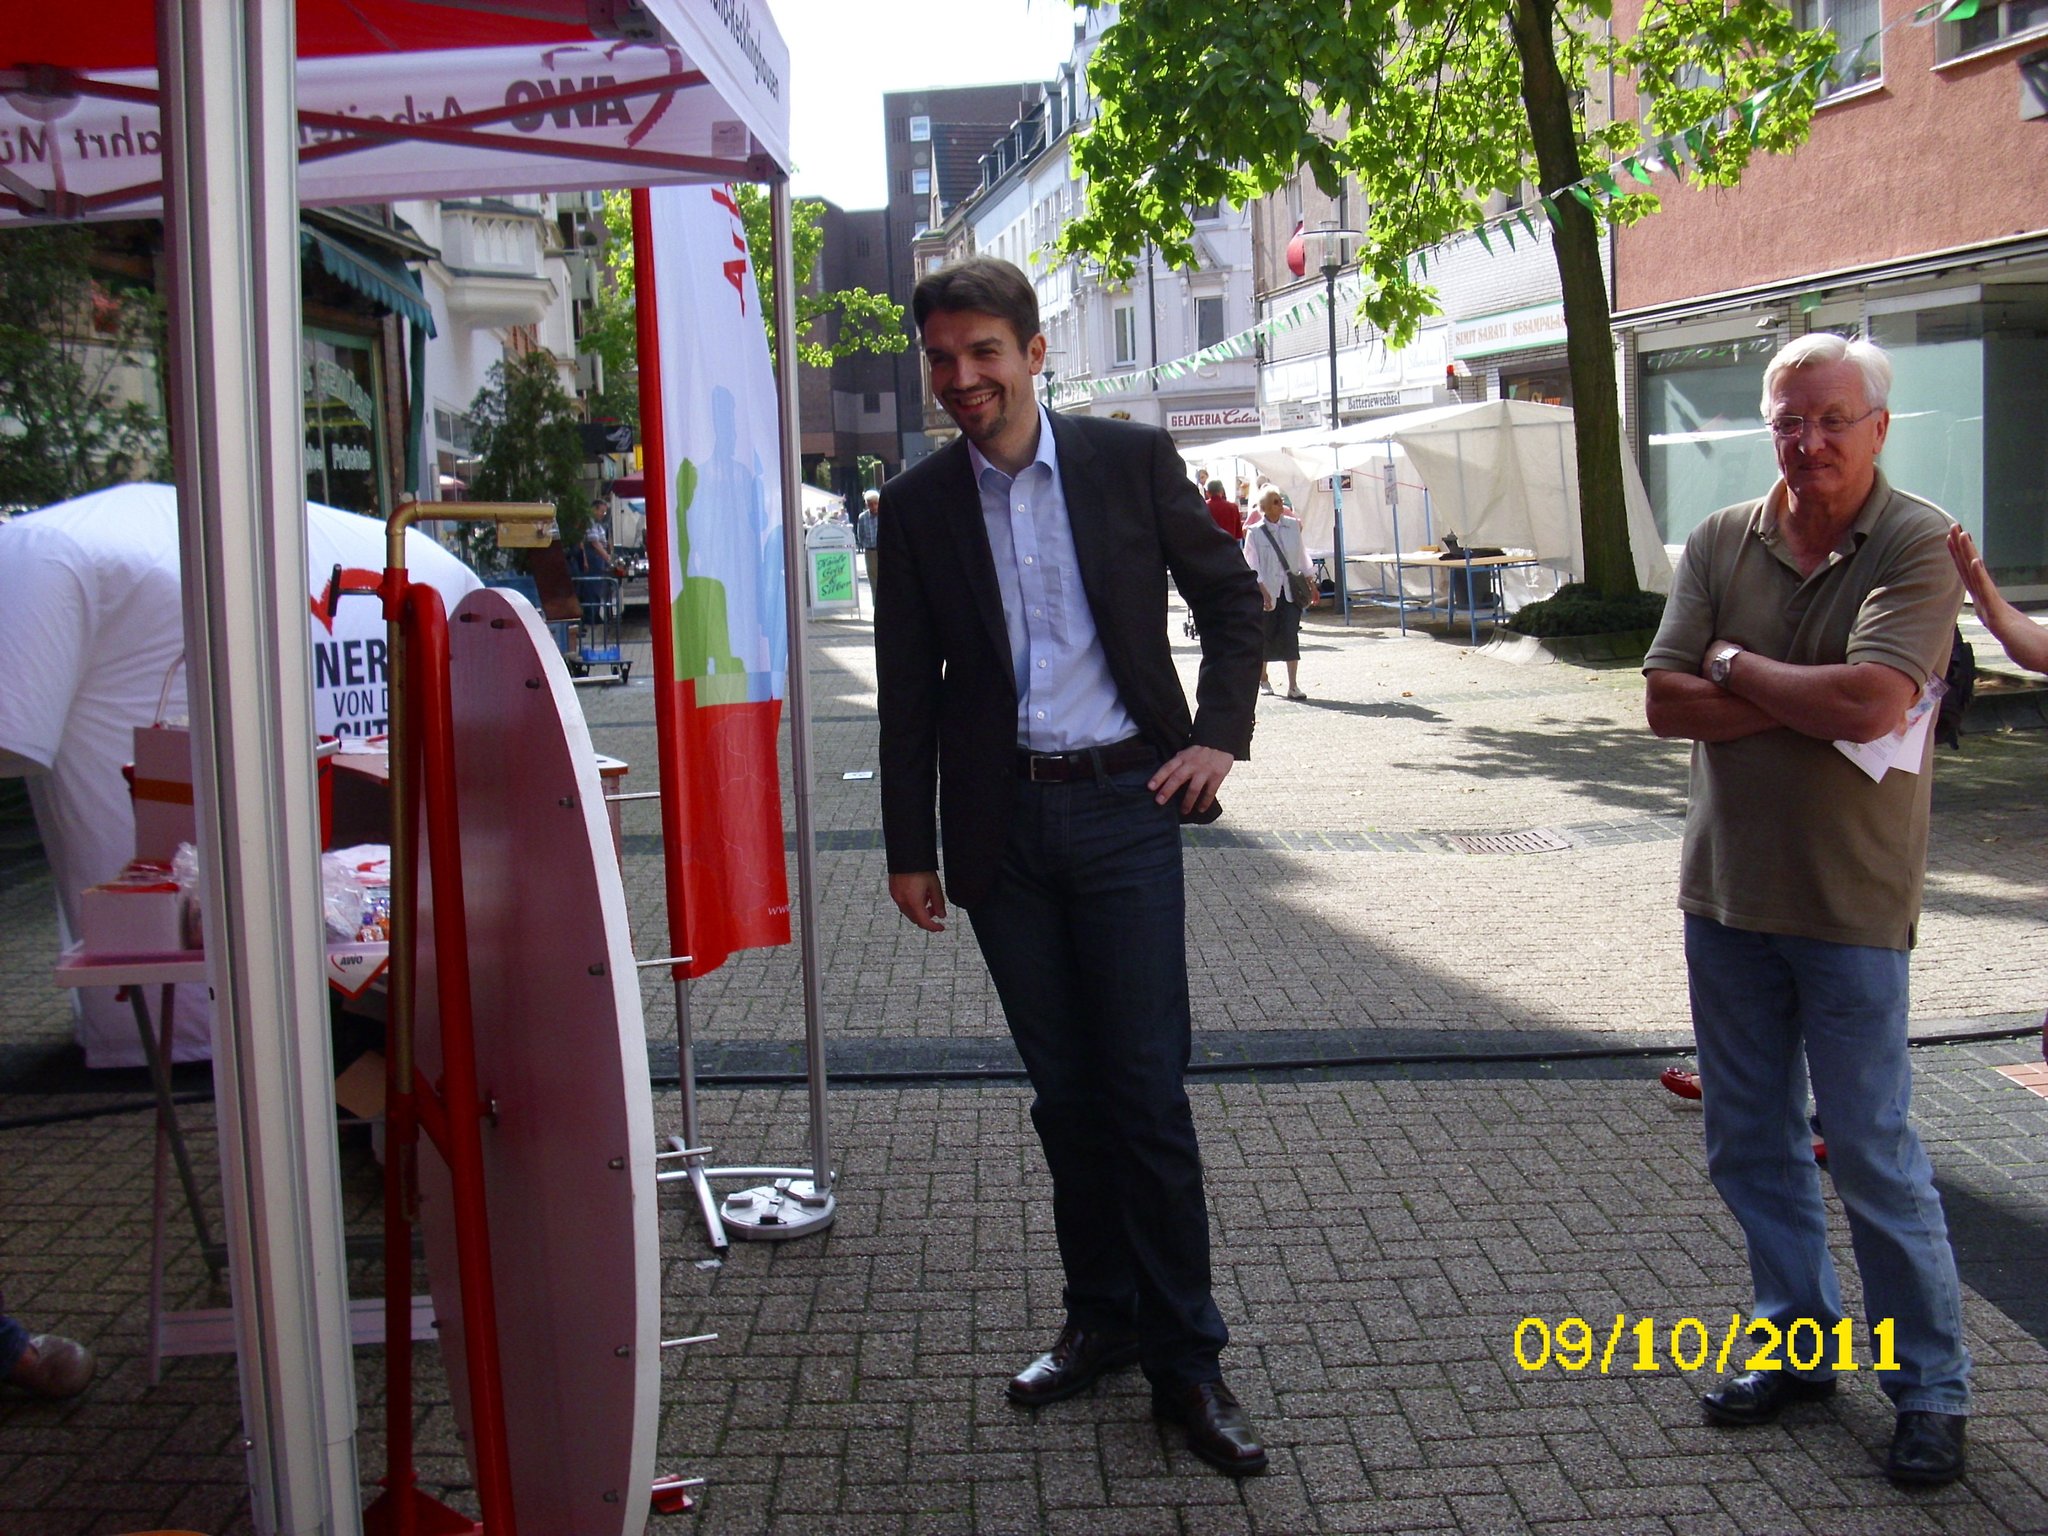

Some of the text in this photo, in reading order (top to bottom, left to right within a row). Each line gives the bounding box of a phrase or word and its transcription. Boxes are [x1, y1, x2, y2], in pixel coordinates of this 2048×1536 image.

[1347, 391, 1401, 410] Batteriewechsel
[1171, 413, 1221, 427] GELATERIA
[333, 690, 373, 717] VON
[341, 956, 362, 965] AWO
